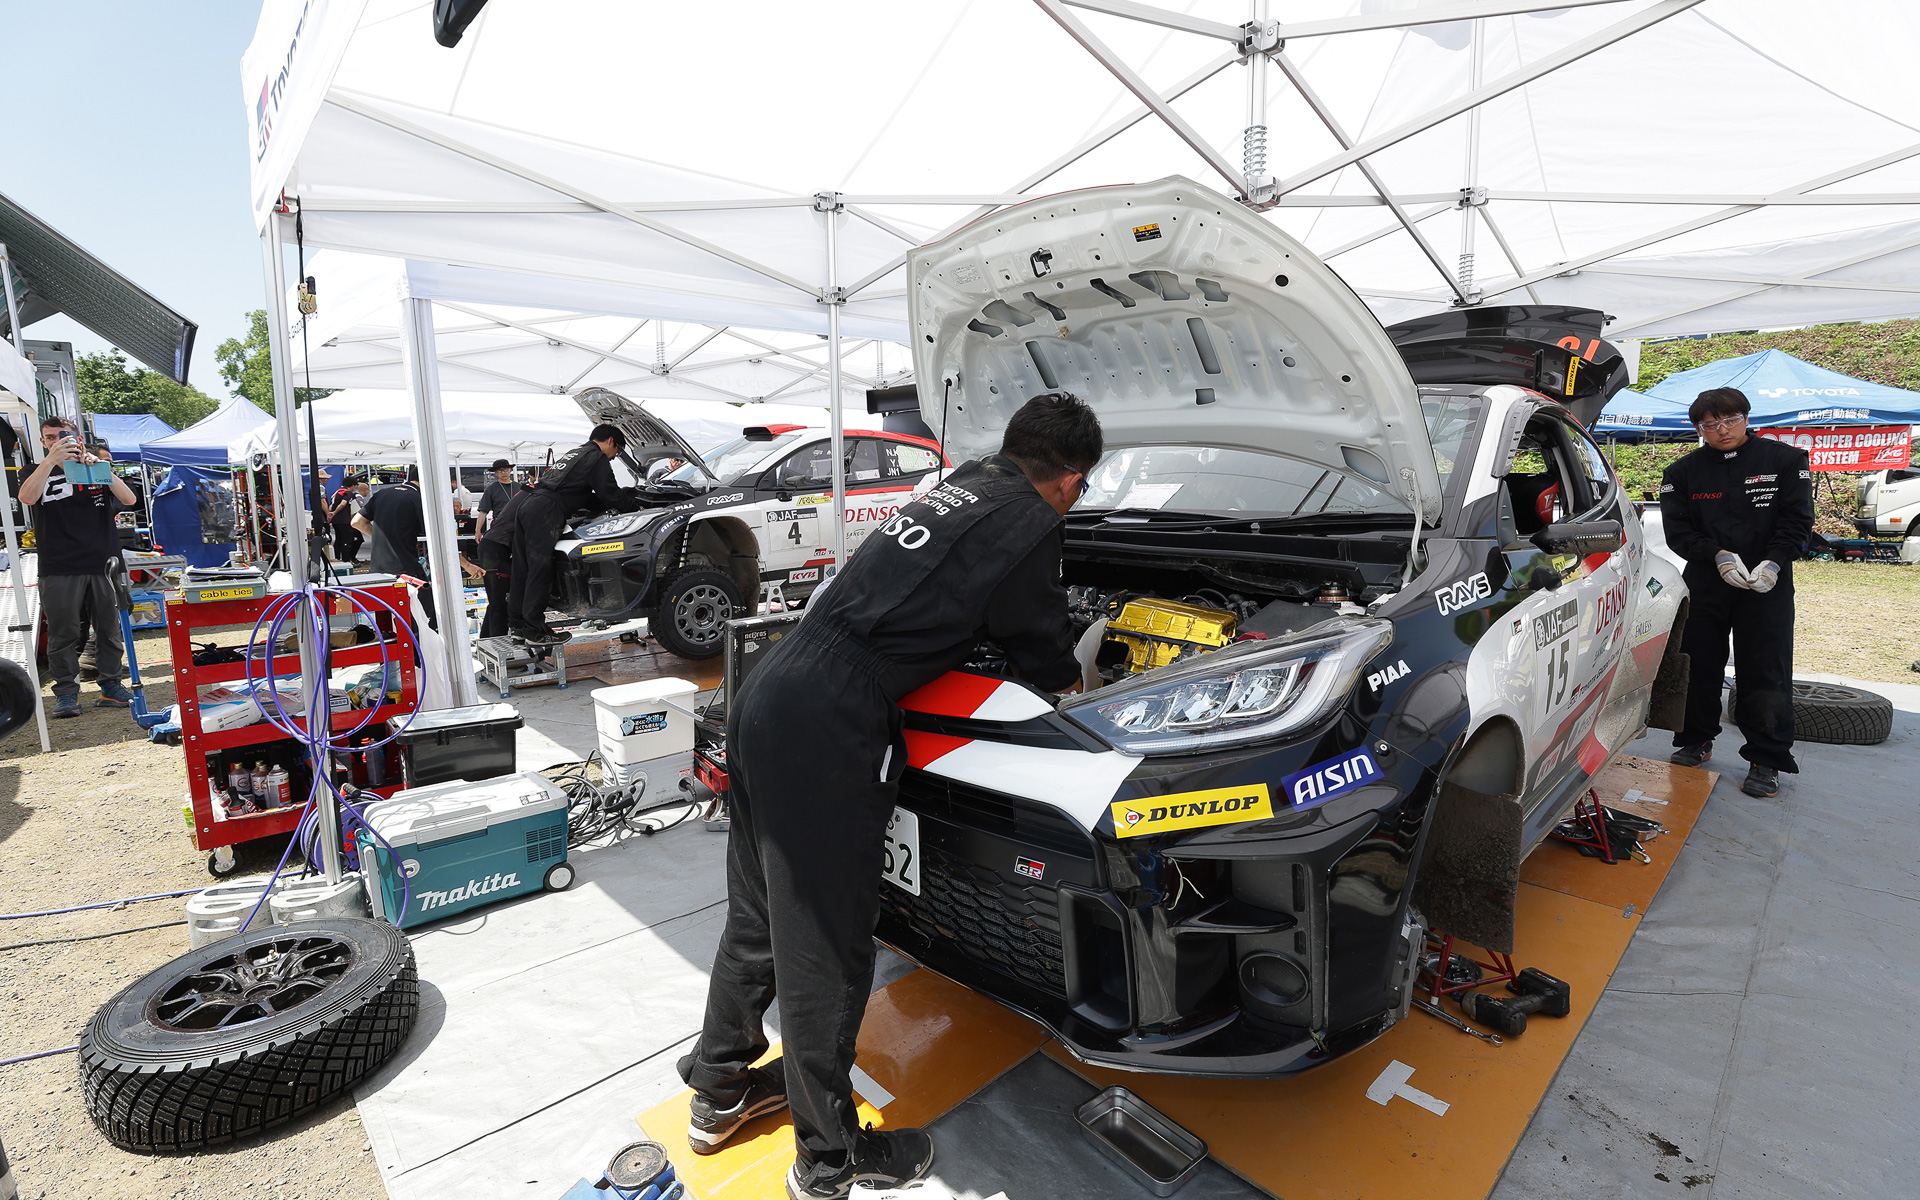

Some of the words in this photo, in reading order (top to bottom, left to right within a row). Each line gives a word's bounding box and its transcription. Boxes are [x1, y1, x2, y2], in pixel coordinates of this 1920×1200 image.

[1790, 387, 1860, 397] TOYOTA
[1597, 414, 1654, 425] 田自動織機
[1815, 434, 1853, 449] SUPER
[1855, 432, 1908, 448] COOLING
[1813, 451, 1860, 465] SYSTEM
[706, 493, 744, 506] RAYS
[928, 489, 963, 508] GZOO
[1692, 491, 1723, 500] DENSO
[674, 503, 695, 511] PIAA
[779, 510, 797, 521] JAF
[788, 522, 801, 545] 4
[589, 544, 621, 552] DUNLOP
[792, 571, 816, 580] KYB
[200, 590, 229, 599] cable
[234, 588, 253, 596] ties
[1435, 571, 1491, 616] RAYS
[1596, 576, 1628, 635] DENSO
[1546, 610, 1562, 642] JAF
[1635, 619, 1653, 638] ENDLESS
[1367, 659, 1412, 693] PIAA
[1546, 639, 1570, 714] 15
[1293, 753, 1375, 805] AISIN
[1148, 795, 1260, 822] DUNLOP
[1016, 862, 1043, 878] GR
[415, 872, 522, 912] makita
